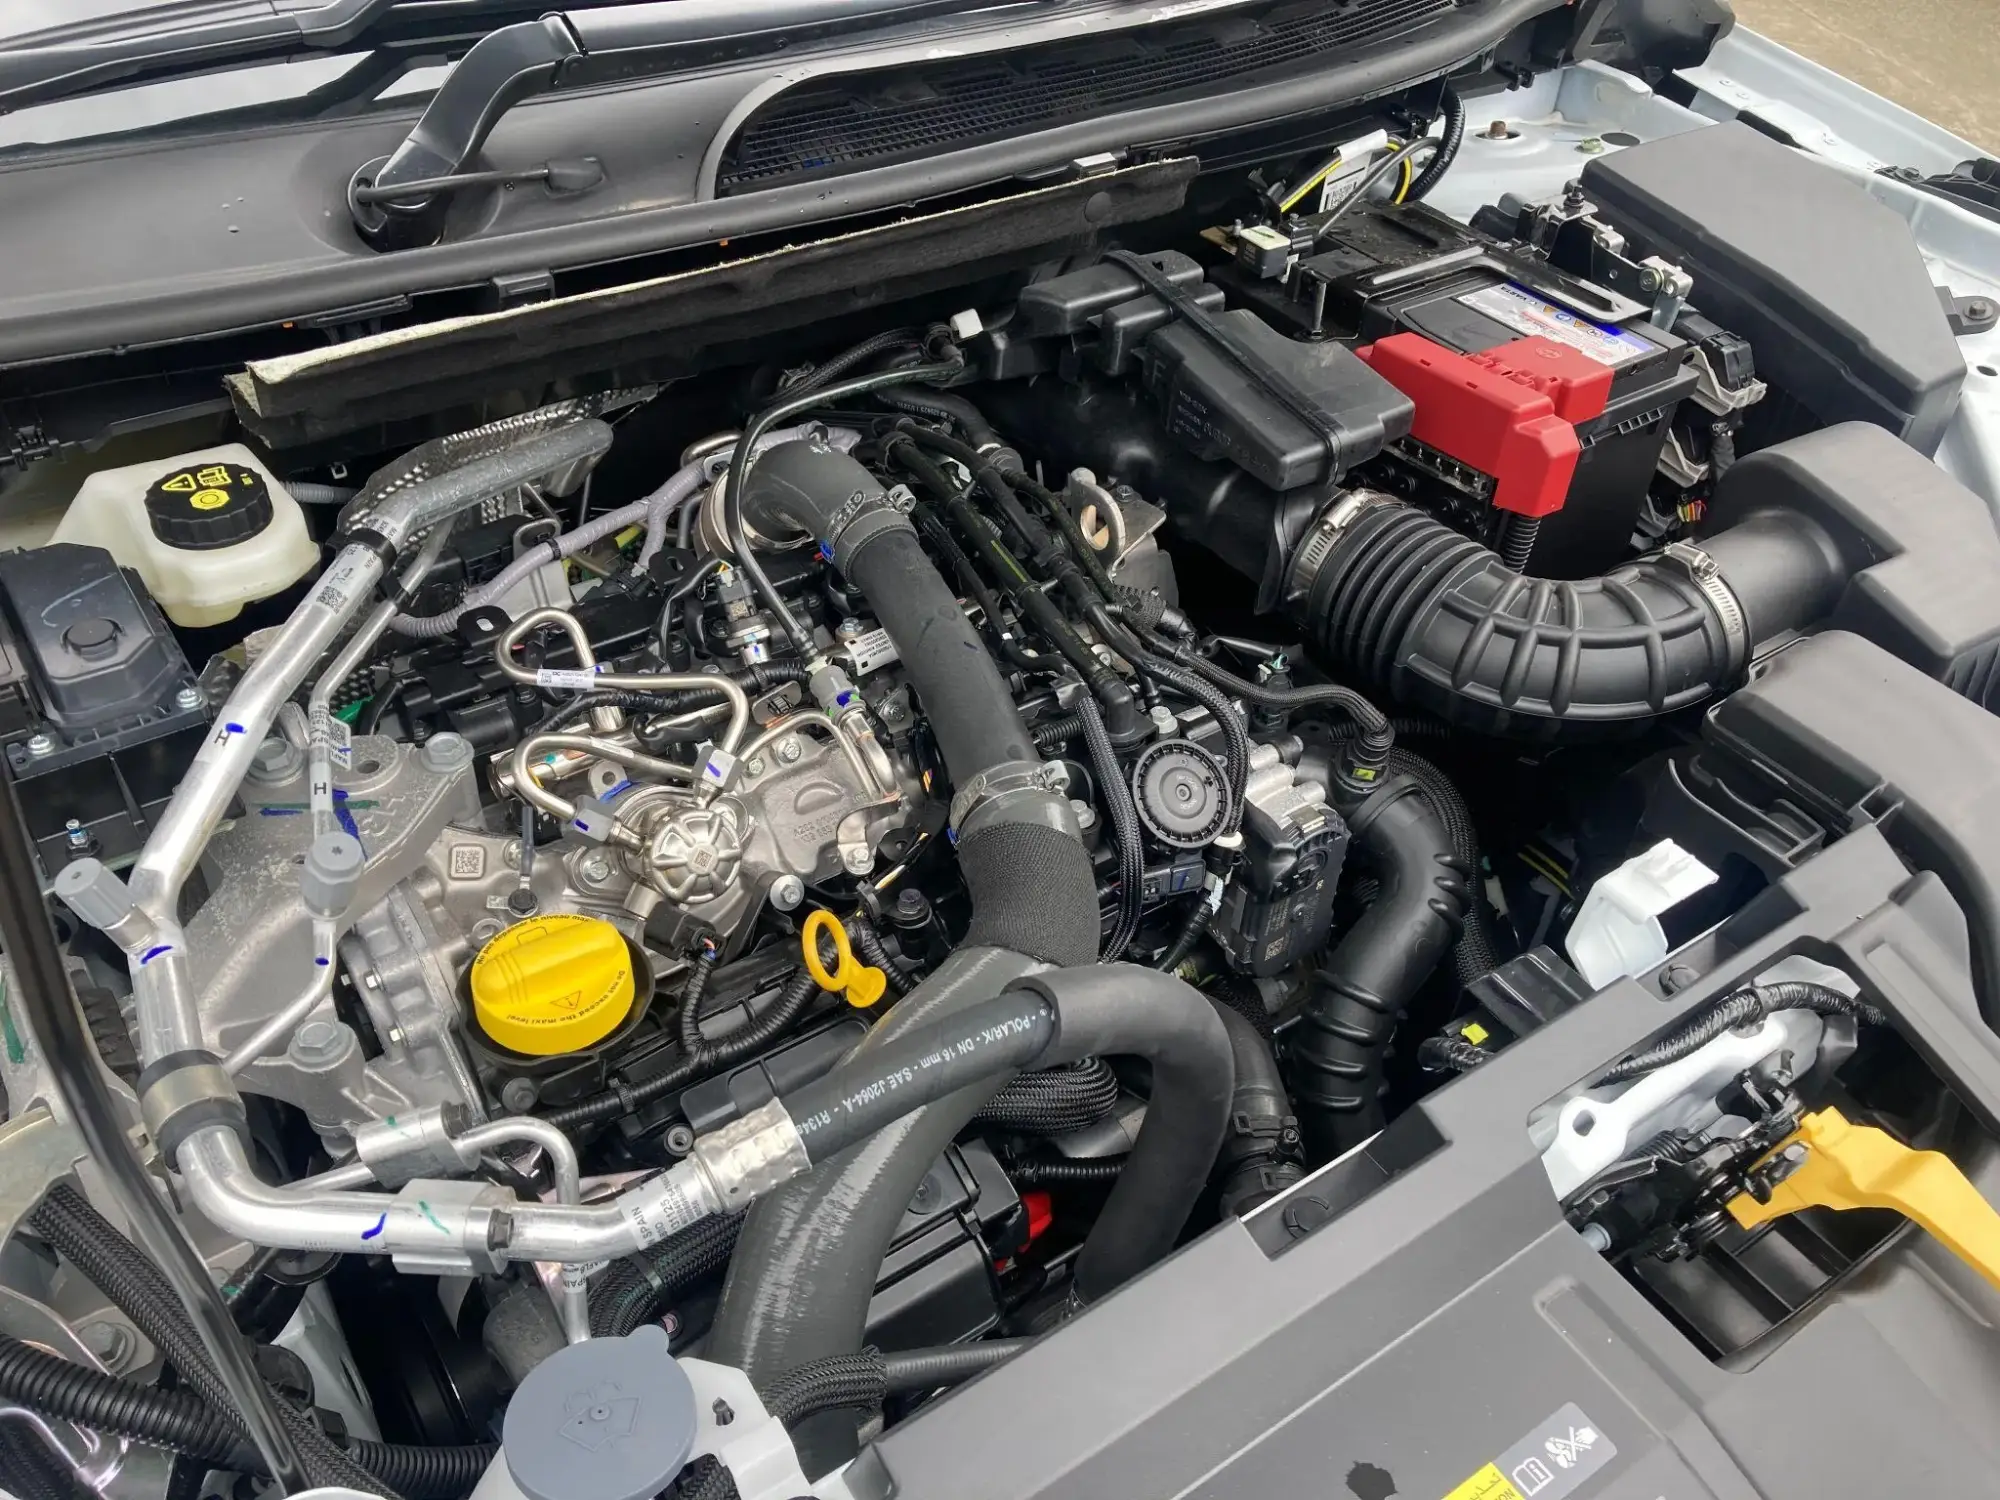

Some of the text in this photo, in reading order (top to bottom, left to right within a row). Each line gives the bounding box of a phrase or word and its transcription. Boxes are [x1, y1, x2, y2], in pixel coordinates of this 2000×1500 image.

[213, 728, 231, 747] H
[313, 781, 327, 796] H
[541, 913, 570, 921] niveau
[981, 1015, 1031, 1045] POLAR/K
[941, 1046, 956, 1062] 16
[956, 1037, 976, 1056] DN
[920, 1052, 941, 1069] mm
[886, 1066, 913, 1090] SAE
[631, 1206, 653, 1239] SPAIN
